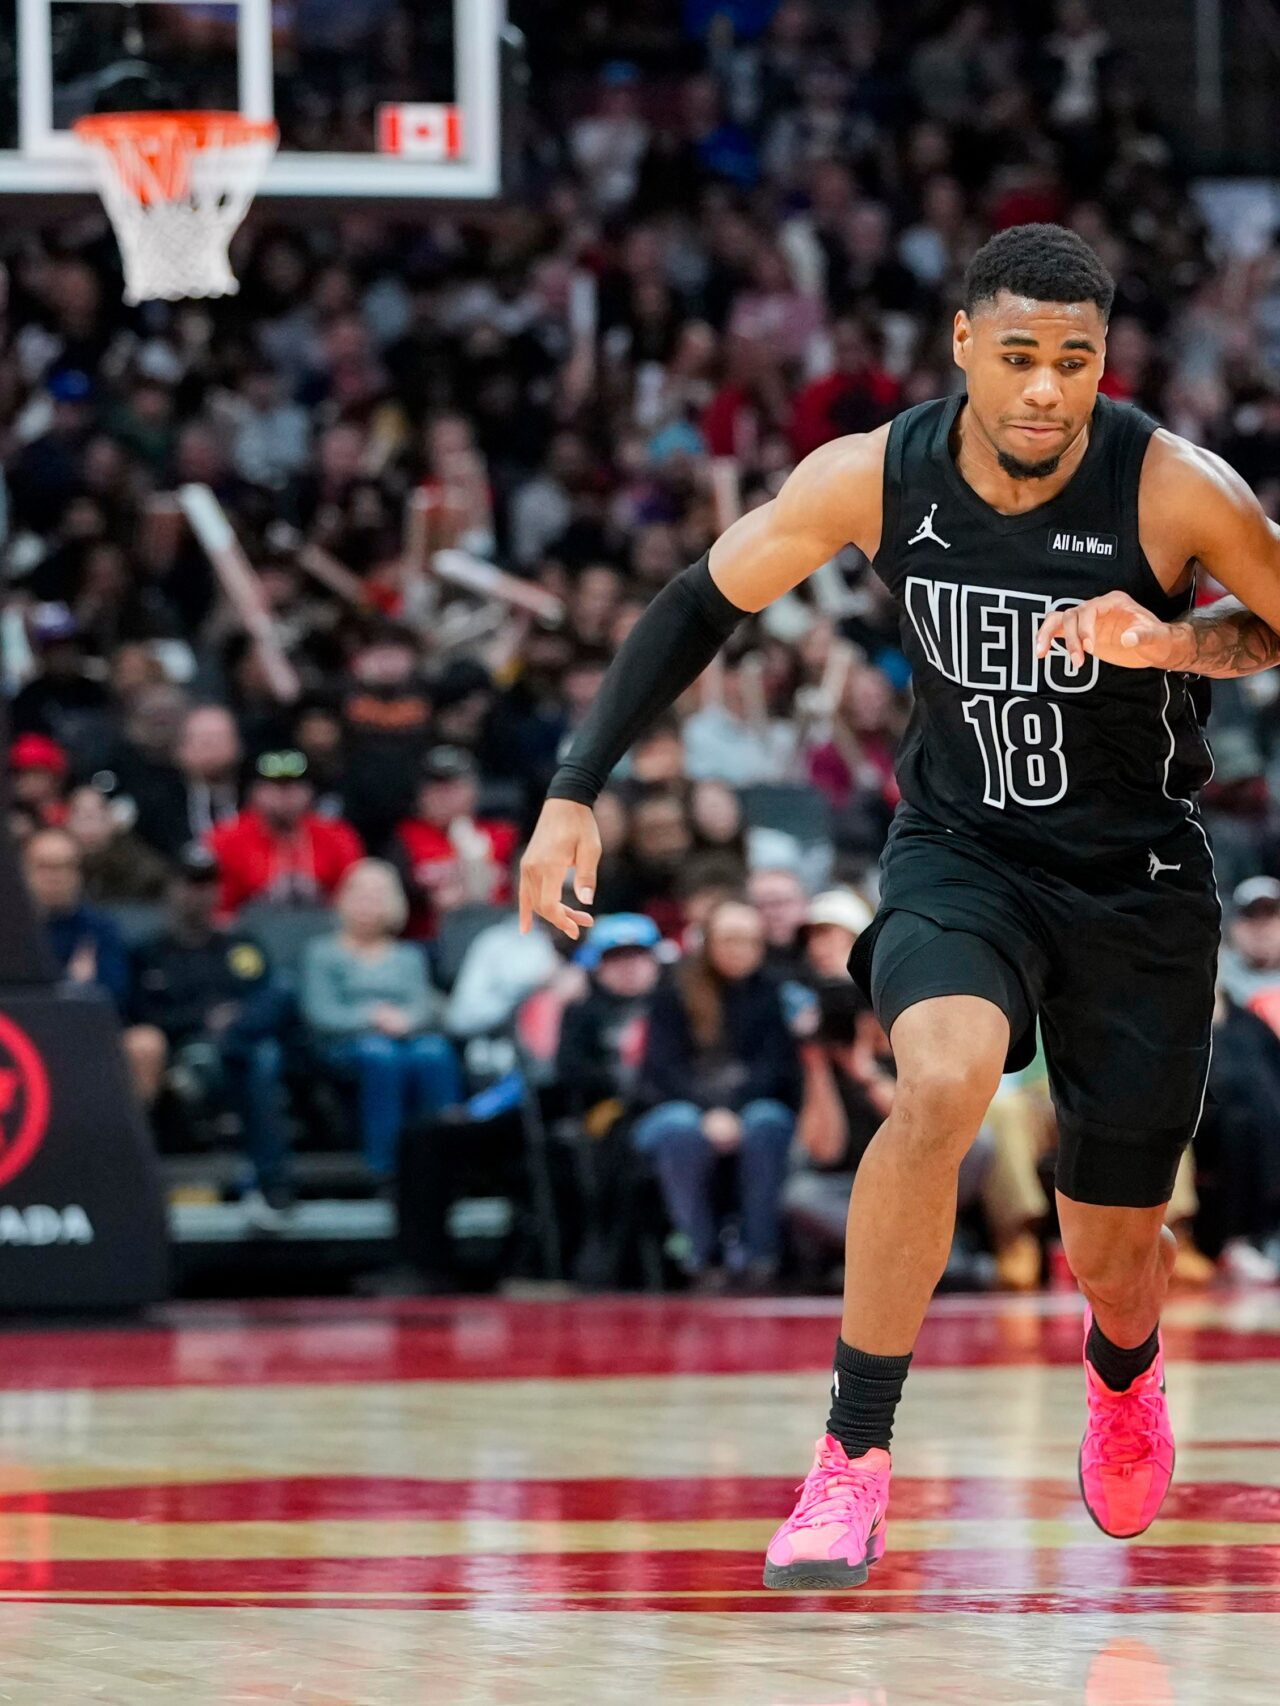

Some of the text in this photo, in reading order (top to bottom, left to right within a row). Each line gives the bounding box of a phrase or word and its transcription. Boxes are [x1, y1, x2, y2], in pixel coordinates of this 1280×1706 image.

[1052, 533, 1113, 556] All In Won
[905, 576, 1099, 693] NETS
[961, 694, 1069, 810] 18
